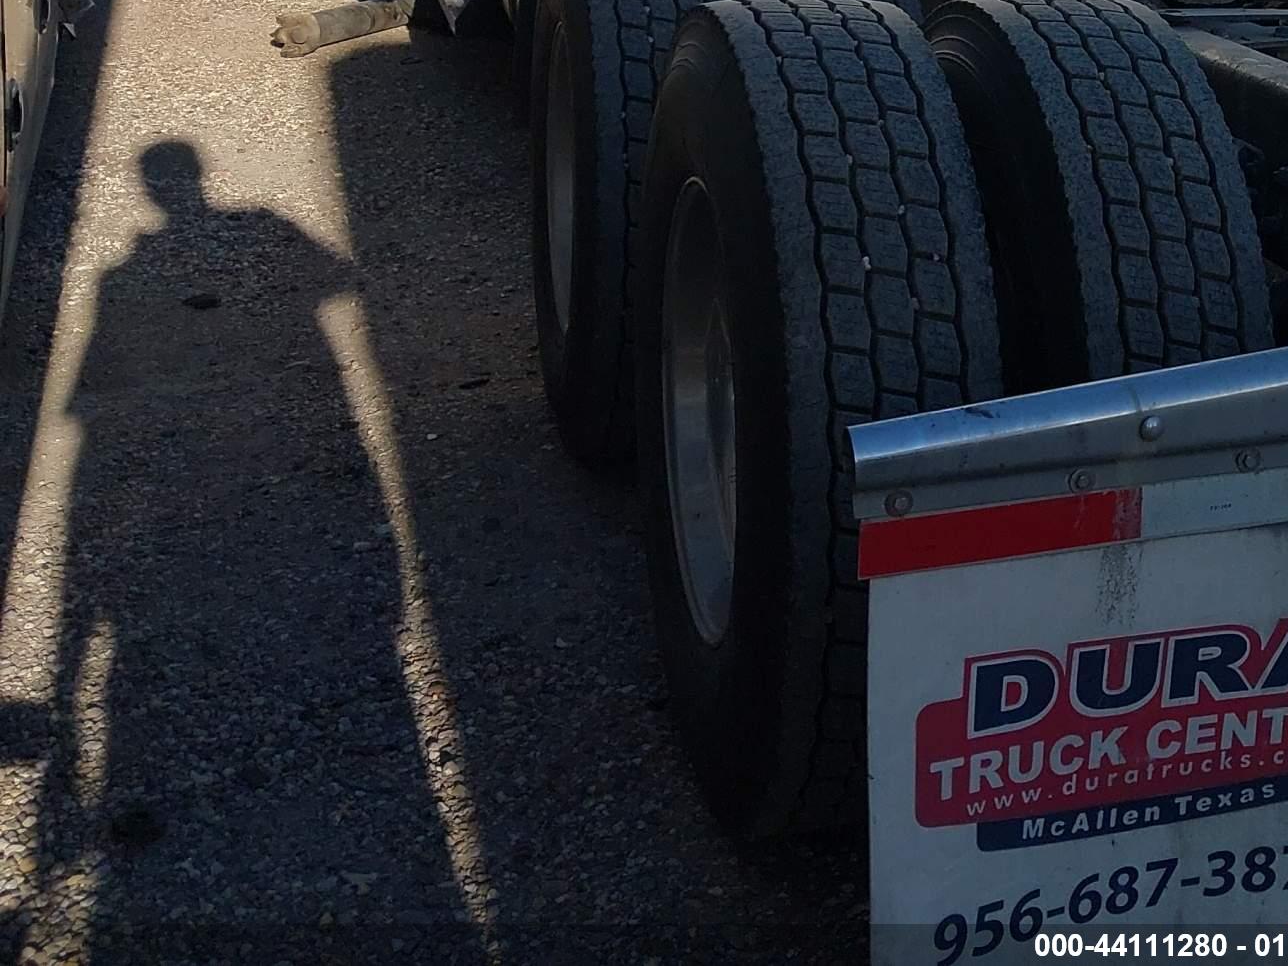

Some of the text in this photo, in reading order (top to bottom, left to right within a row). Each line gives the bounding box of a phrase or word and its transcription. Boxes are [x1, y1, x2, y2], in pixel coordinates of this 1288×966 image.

[930, 725, 1134, 801] TRUCK
[1022, 782, 1277, 840] McAllen Texas
